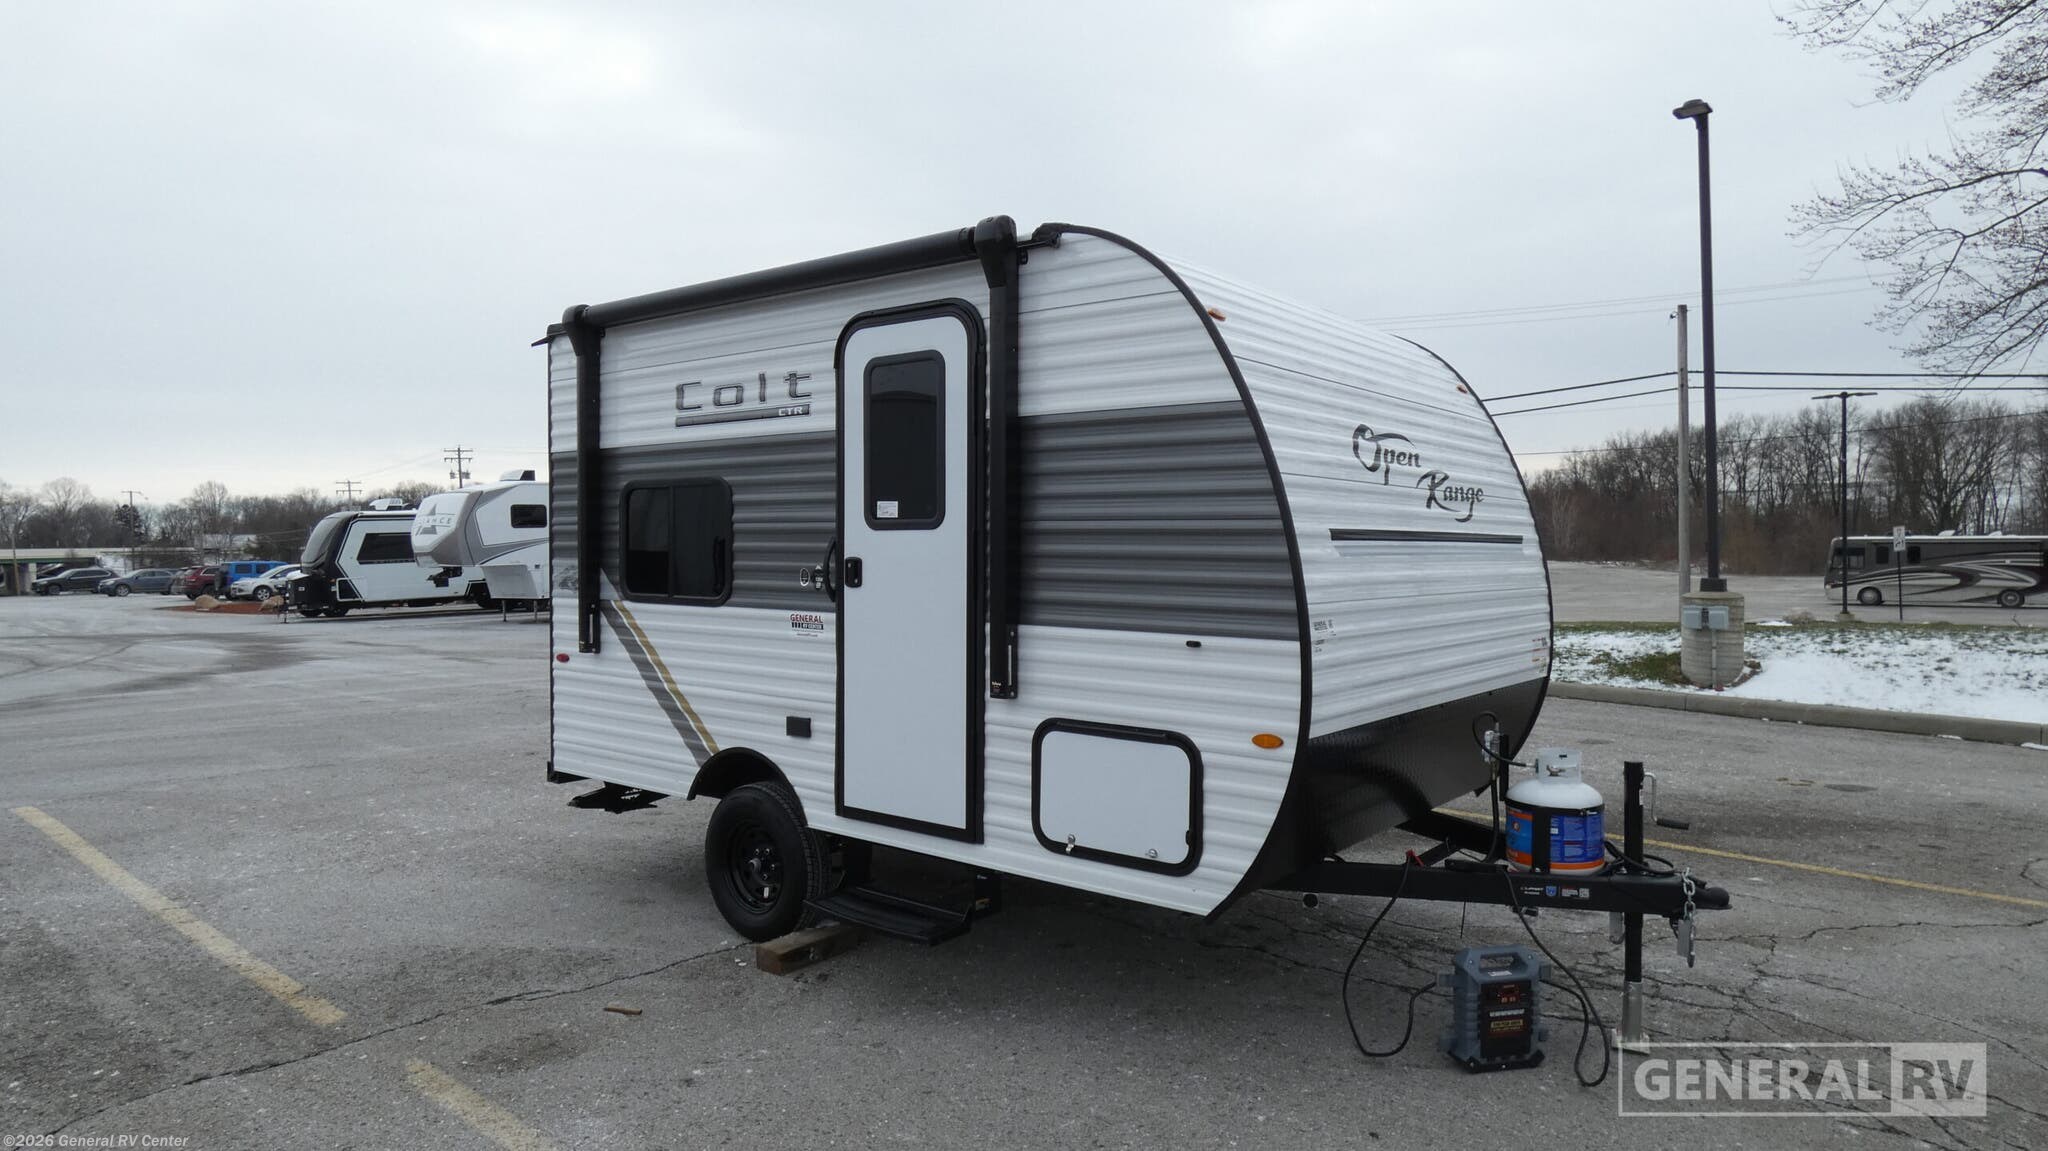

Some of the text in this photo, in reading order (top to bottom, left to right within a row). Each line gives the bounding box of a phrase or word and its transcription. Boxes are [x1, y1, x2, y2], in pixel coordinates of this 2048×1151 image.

[676, 372, 812, 411] Colt
[778, 406, 803, 416] CTR
[1352, 423, 1422, 486] Open
[1415, 469, 1485, 523] Range
[790, 613, 824, 624] GENERAL
